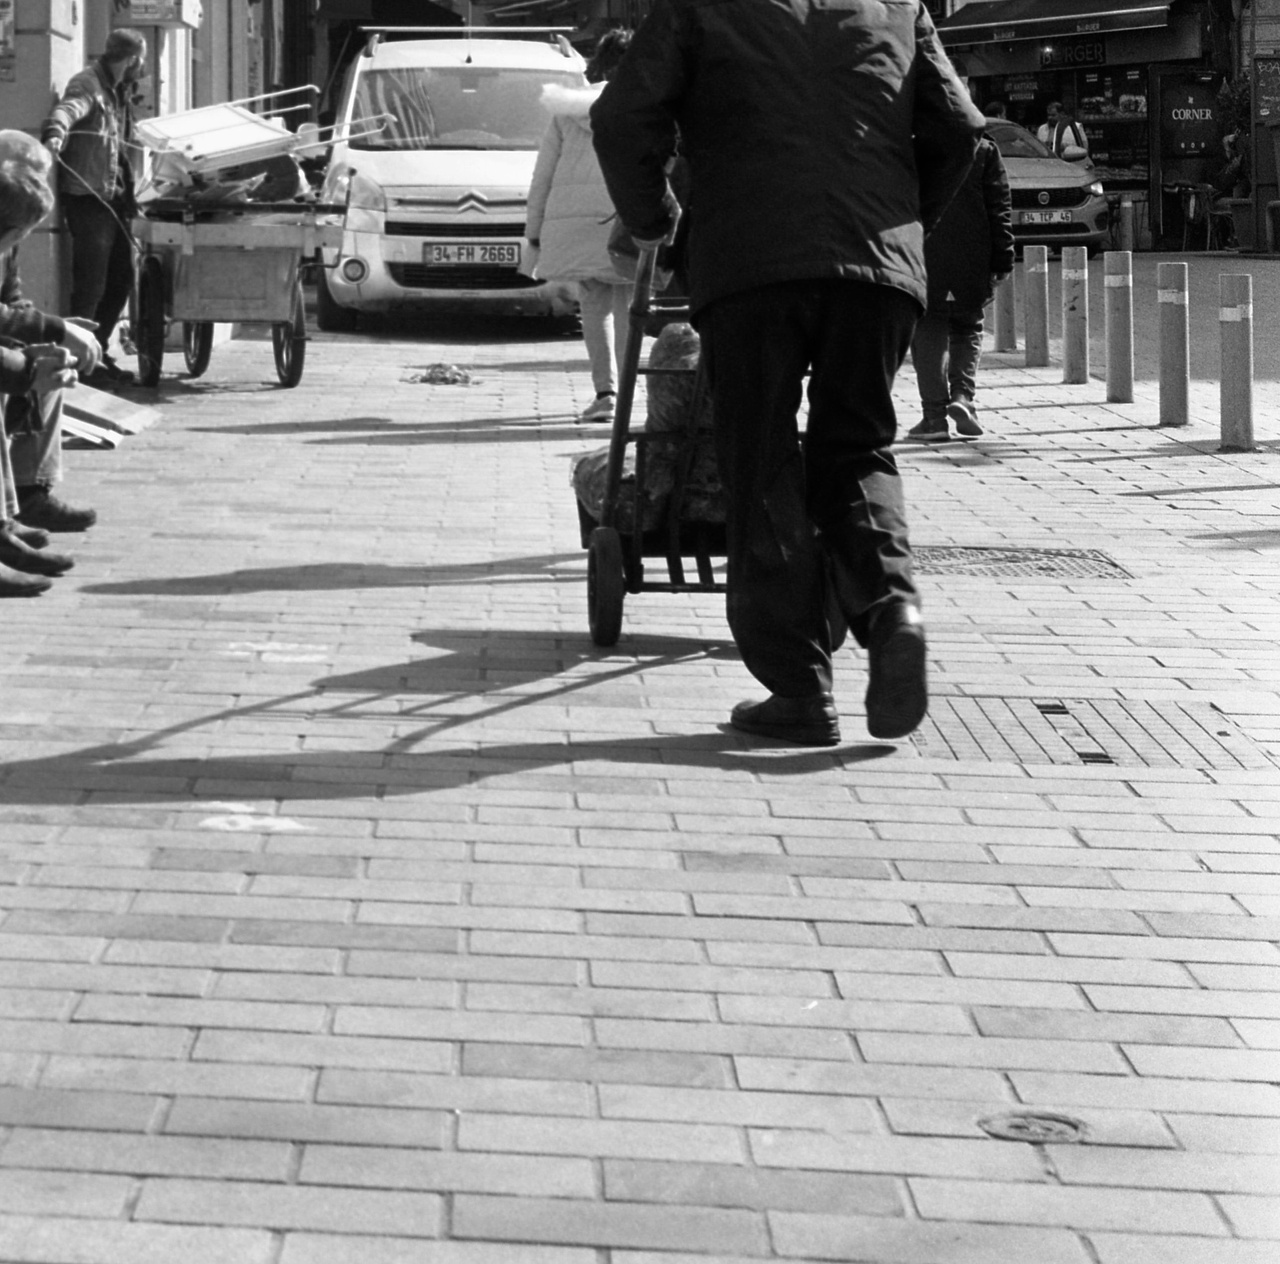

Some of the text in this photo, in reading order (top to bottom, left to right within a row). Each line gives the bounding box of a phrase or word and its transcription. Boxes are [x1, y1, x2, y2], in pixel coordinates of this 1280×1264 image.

[1042, 42, 1104, 65] BRGER
[1171, 108, 1213, 120] CORNER
[1025, 212, 1070, 222] 34 TCP 46
[434, 245, 515, 262] 34 FH 2669
